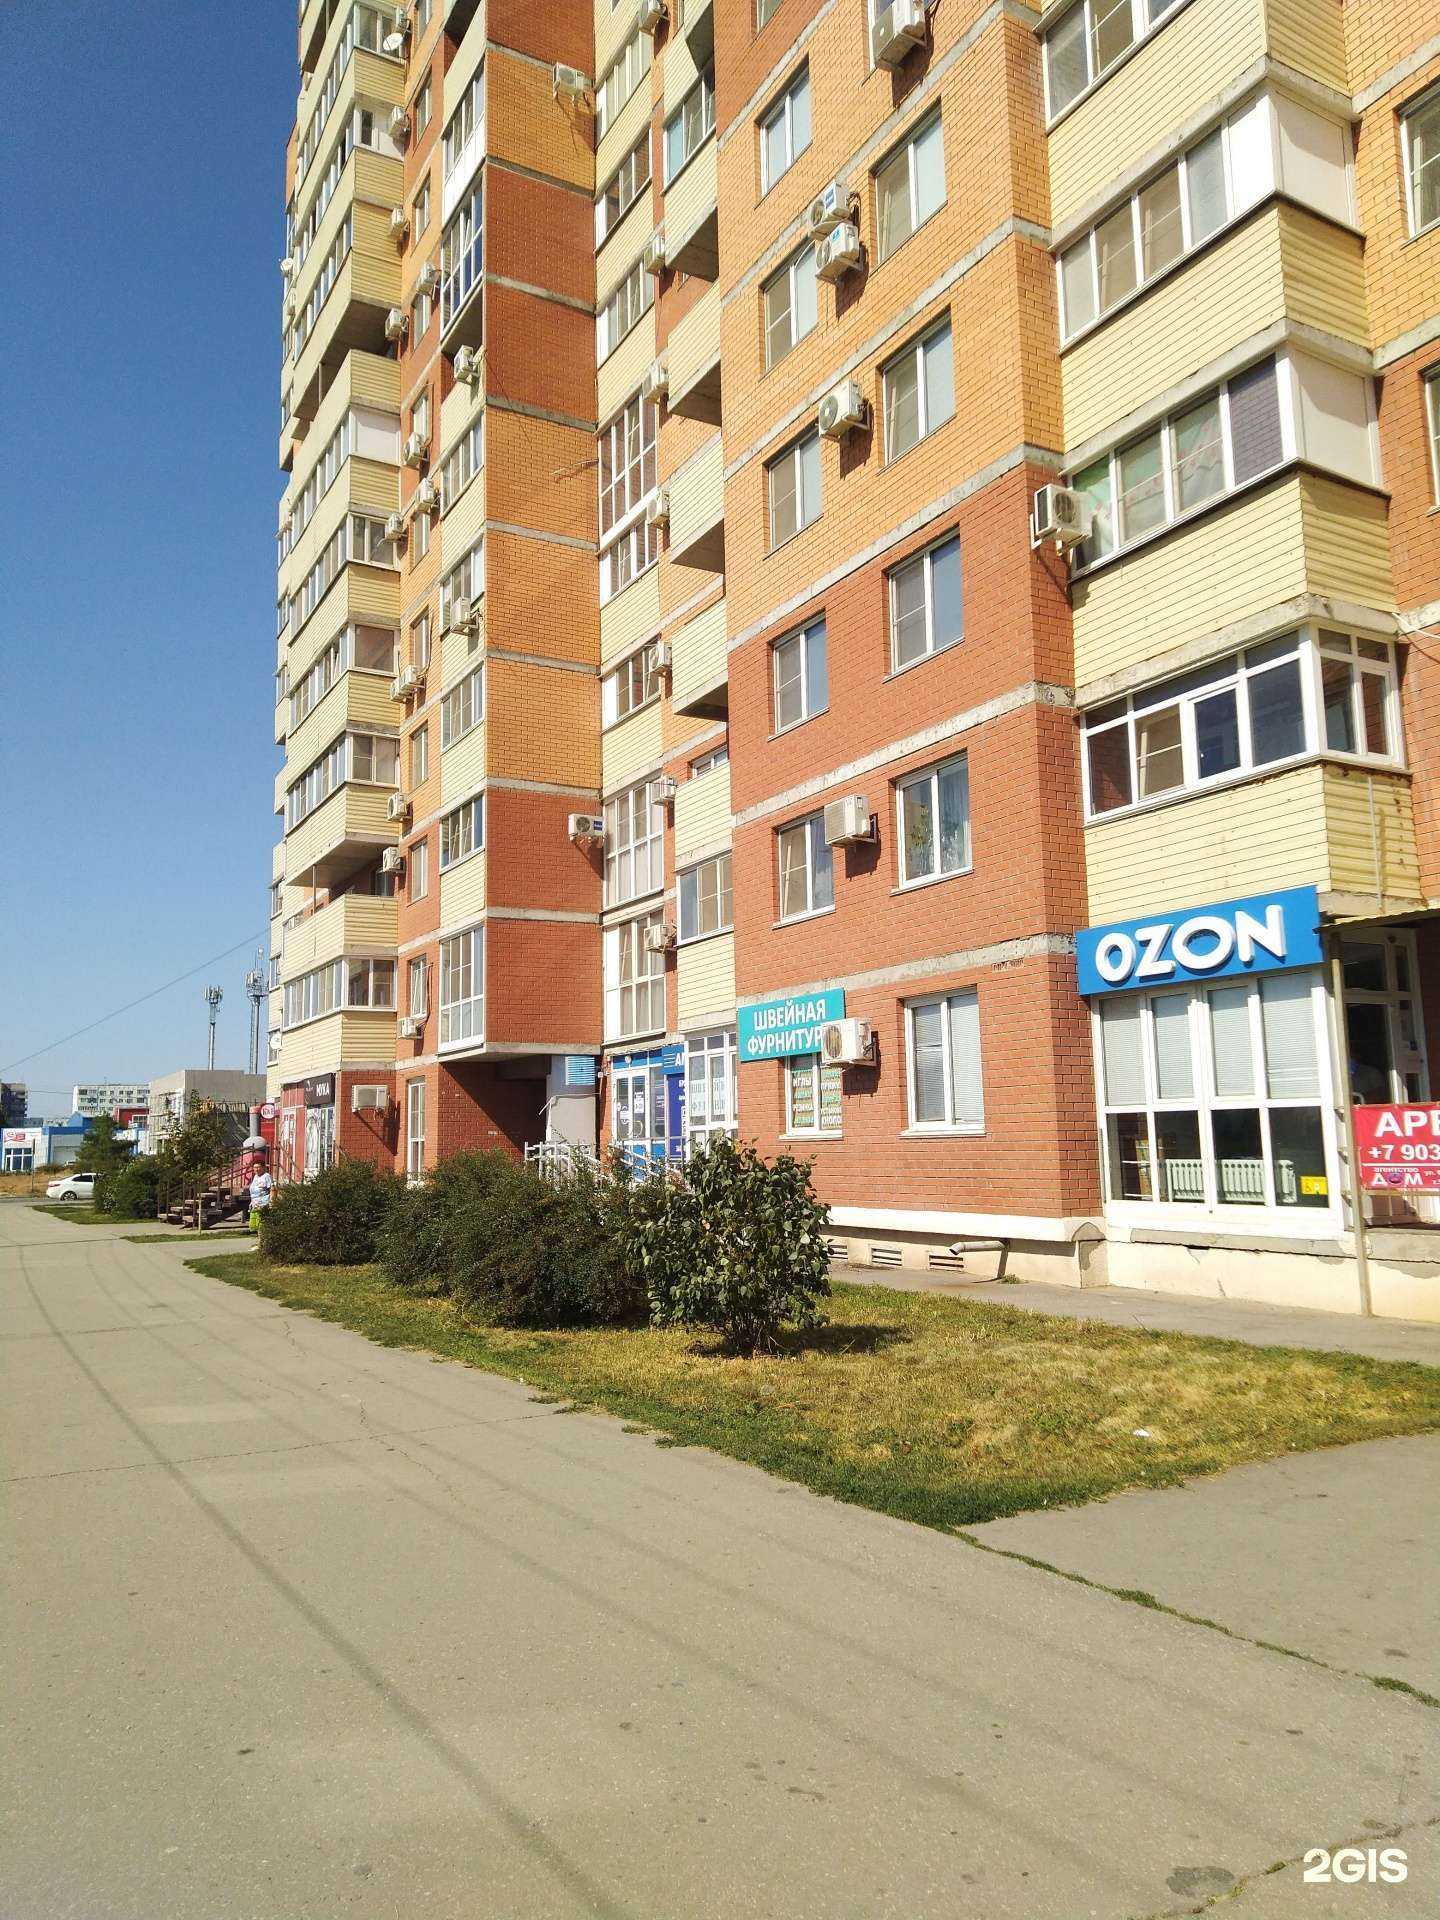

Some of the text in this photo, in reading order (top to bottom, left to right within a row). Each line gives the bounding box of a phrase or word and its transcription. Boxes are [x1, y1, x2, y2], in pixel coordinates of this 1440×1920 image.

[1096, 905, 1287, 982] OZON
[754, 999, 826, 1031] ШВЕЙНАЯ
[792, 1077, 812, 1087] ИГЛЫ
[1367, 1144, 1440, 1160] +7 903
